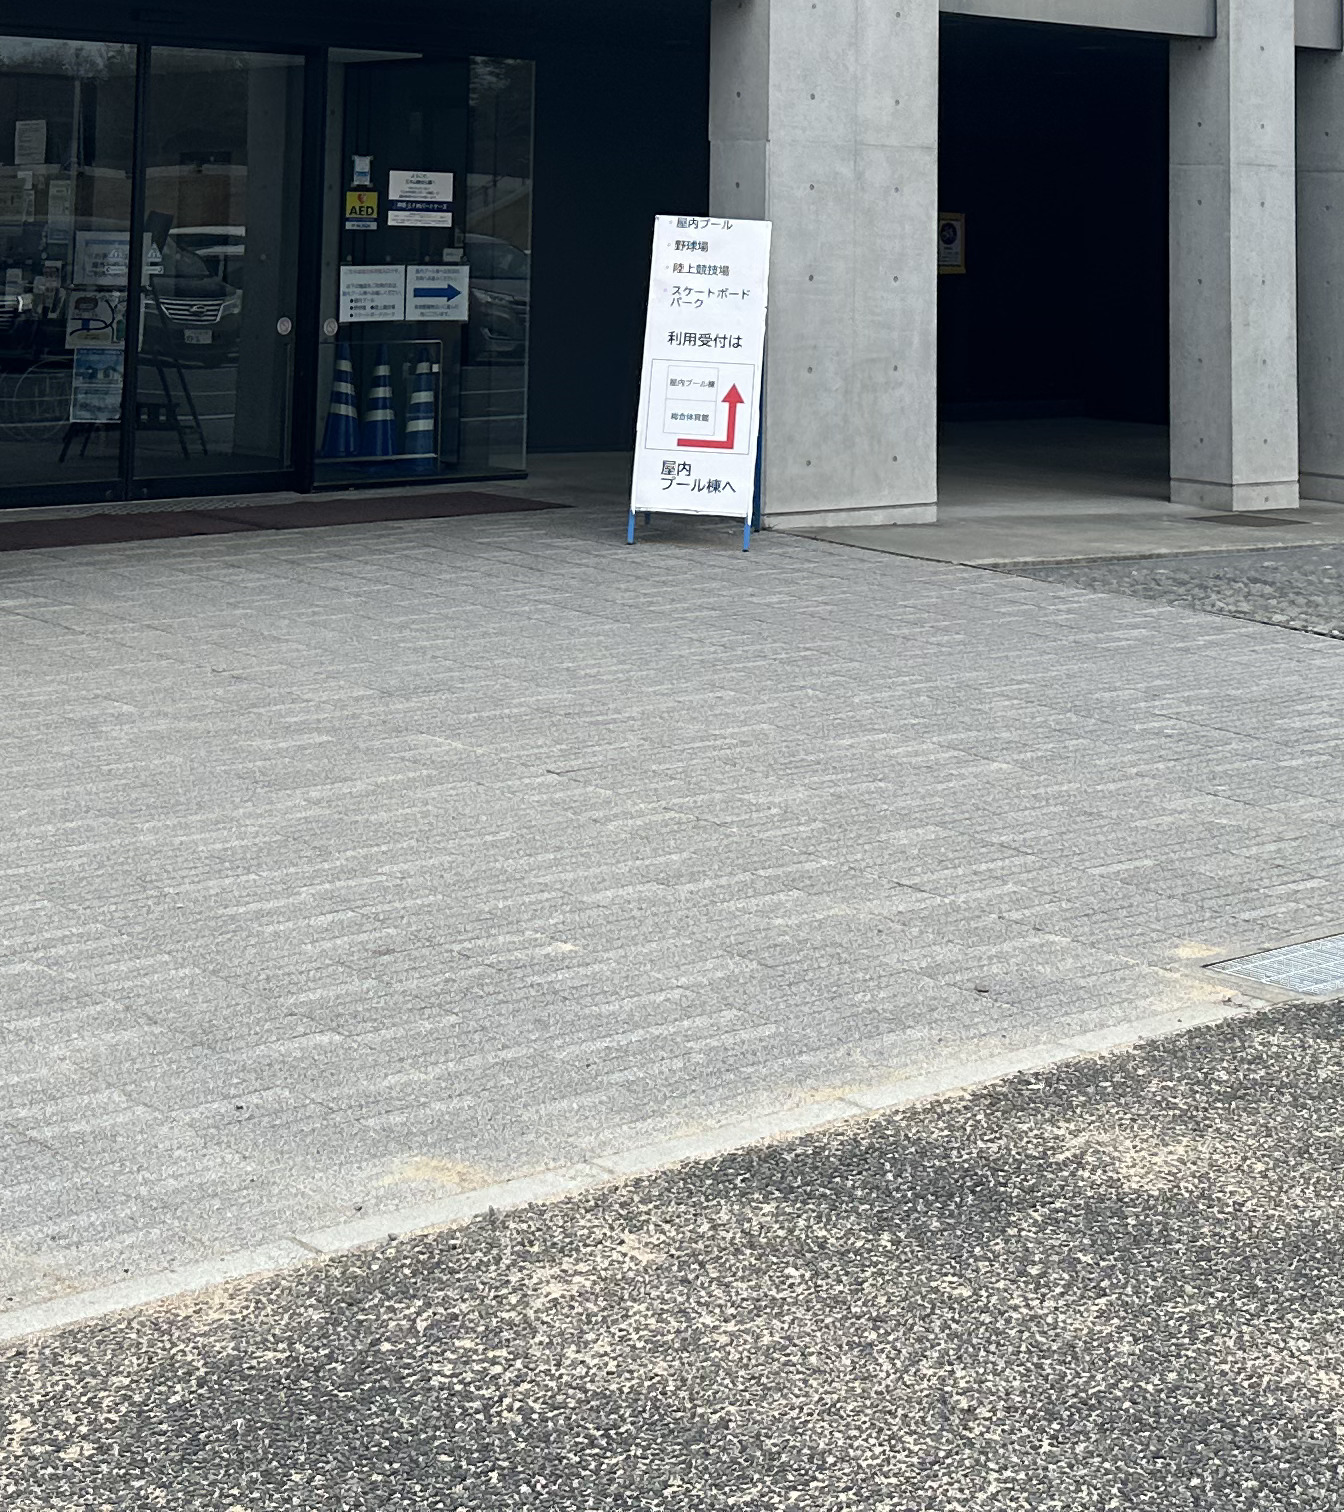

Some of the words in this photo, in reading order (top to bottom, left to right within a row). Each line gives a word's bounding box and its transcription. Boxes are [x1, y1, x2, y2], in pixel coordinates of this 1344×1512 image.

[349, 206, 374, 216] AED
[676, 217, 733, 230] 屋内プール
[674, 240, 709, 253] 野球場
[672, 263, 730, 277] 陸上競技場
[671, 285, 751, 300] スケートボード
[670, 297, 704, 308] パーク
[667, 331, 743, 349] 利用受付は
[661, 460, 692, 476] 屋内
[660, 476, 737, 494] プール棟へ
